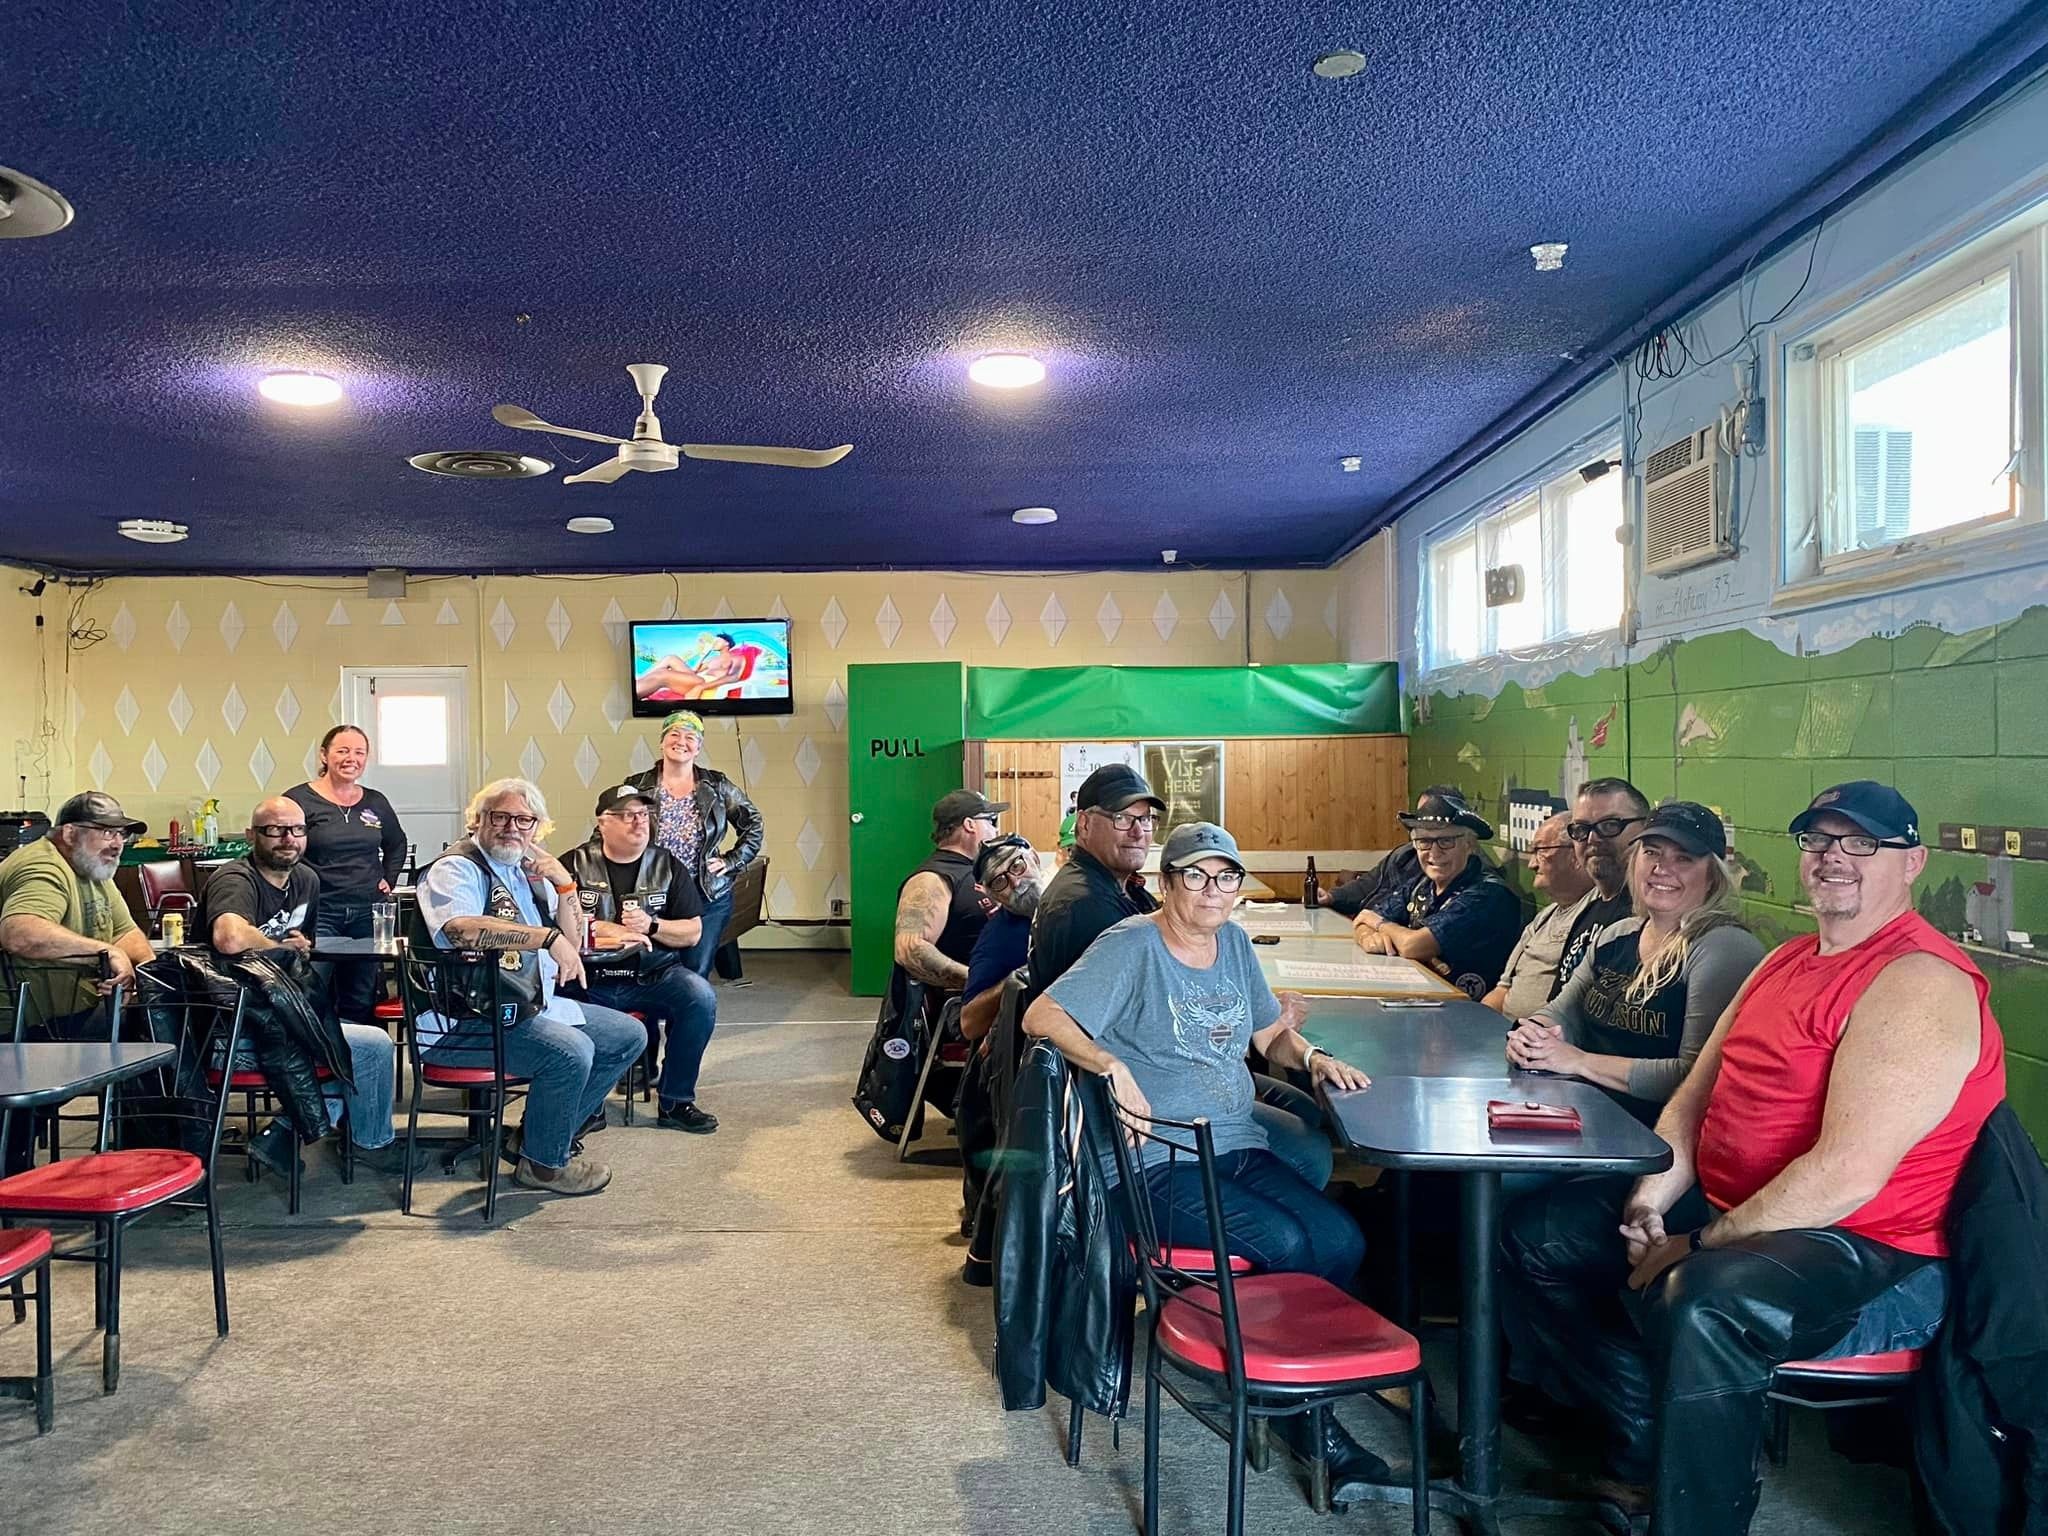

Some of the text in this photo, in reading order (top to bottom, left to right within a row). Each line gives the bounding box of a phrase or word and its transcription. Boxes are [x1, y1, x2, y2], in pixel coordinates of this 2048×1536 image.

[871, 738, 925, 758] PULL
[1164, 779, 1201, 793] HERE
[497, 907, 515, 918] HOG
